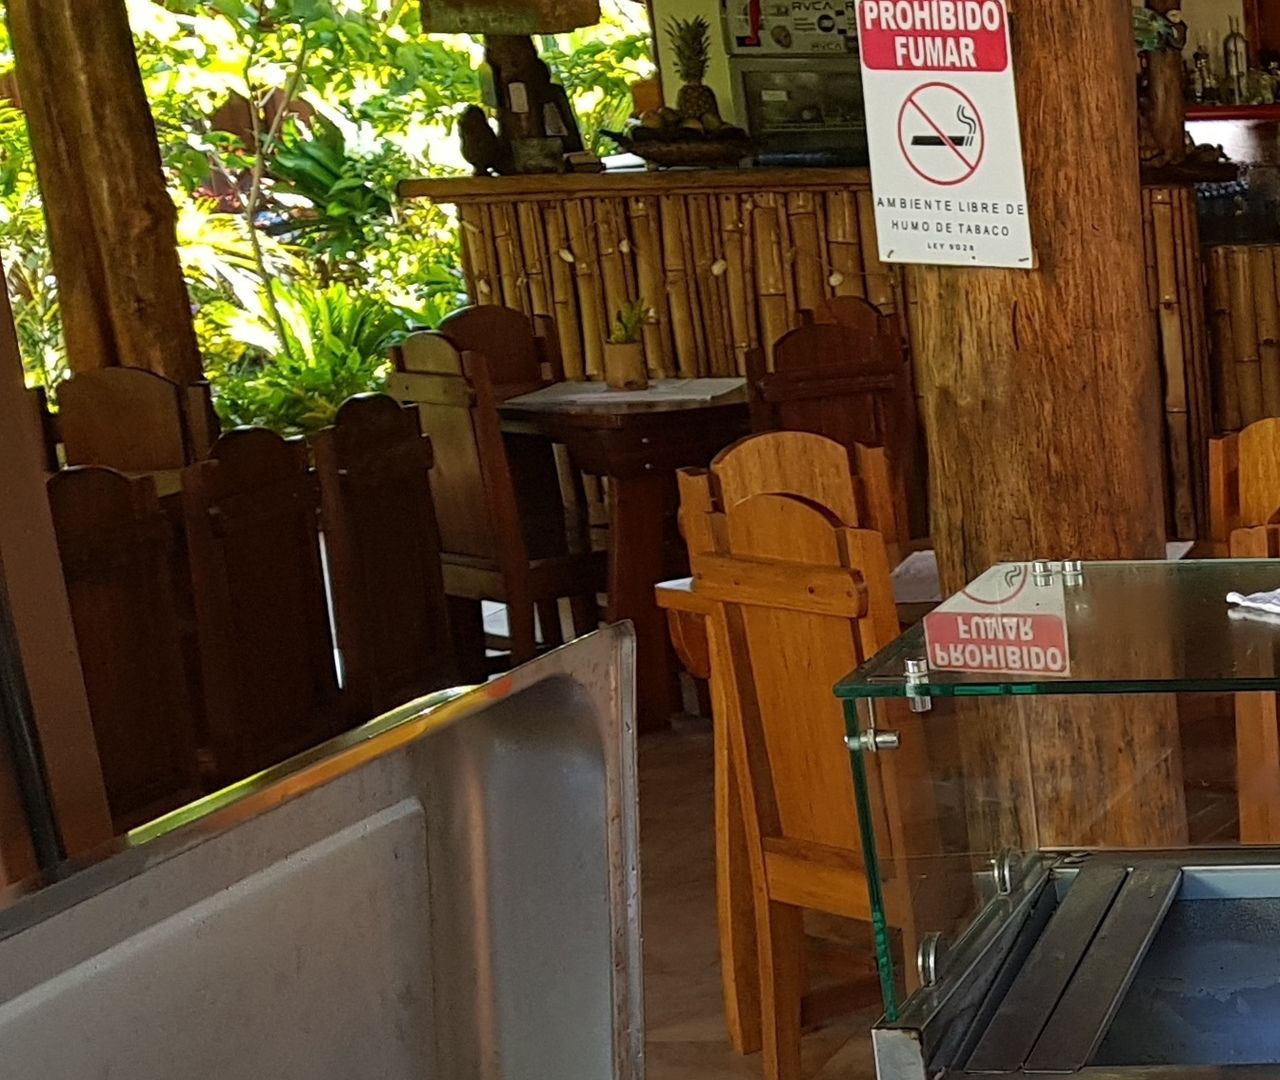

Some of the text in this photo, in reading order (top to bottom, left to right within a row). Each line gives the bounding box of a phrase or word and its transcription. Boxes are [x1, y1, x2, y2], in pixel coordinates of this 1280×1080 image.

[864, 0, 1000, 31] PROHIBIDO
[894, 35, 977, 68] FUMAR
[877, 197, 1025, 216] AMBIENTE LIBRE DE
[891, 219, 1009, 236] HUMO DE TABACO
[927, 242, 945, 250] LEY
